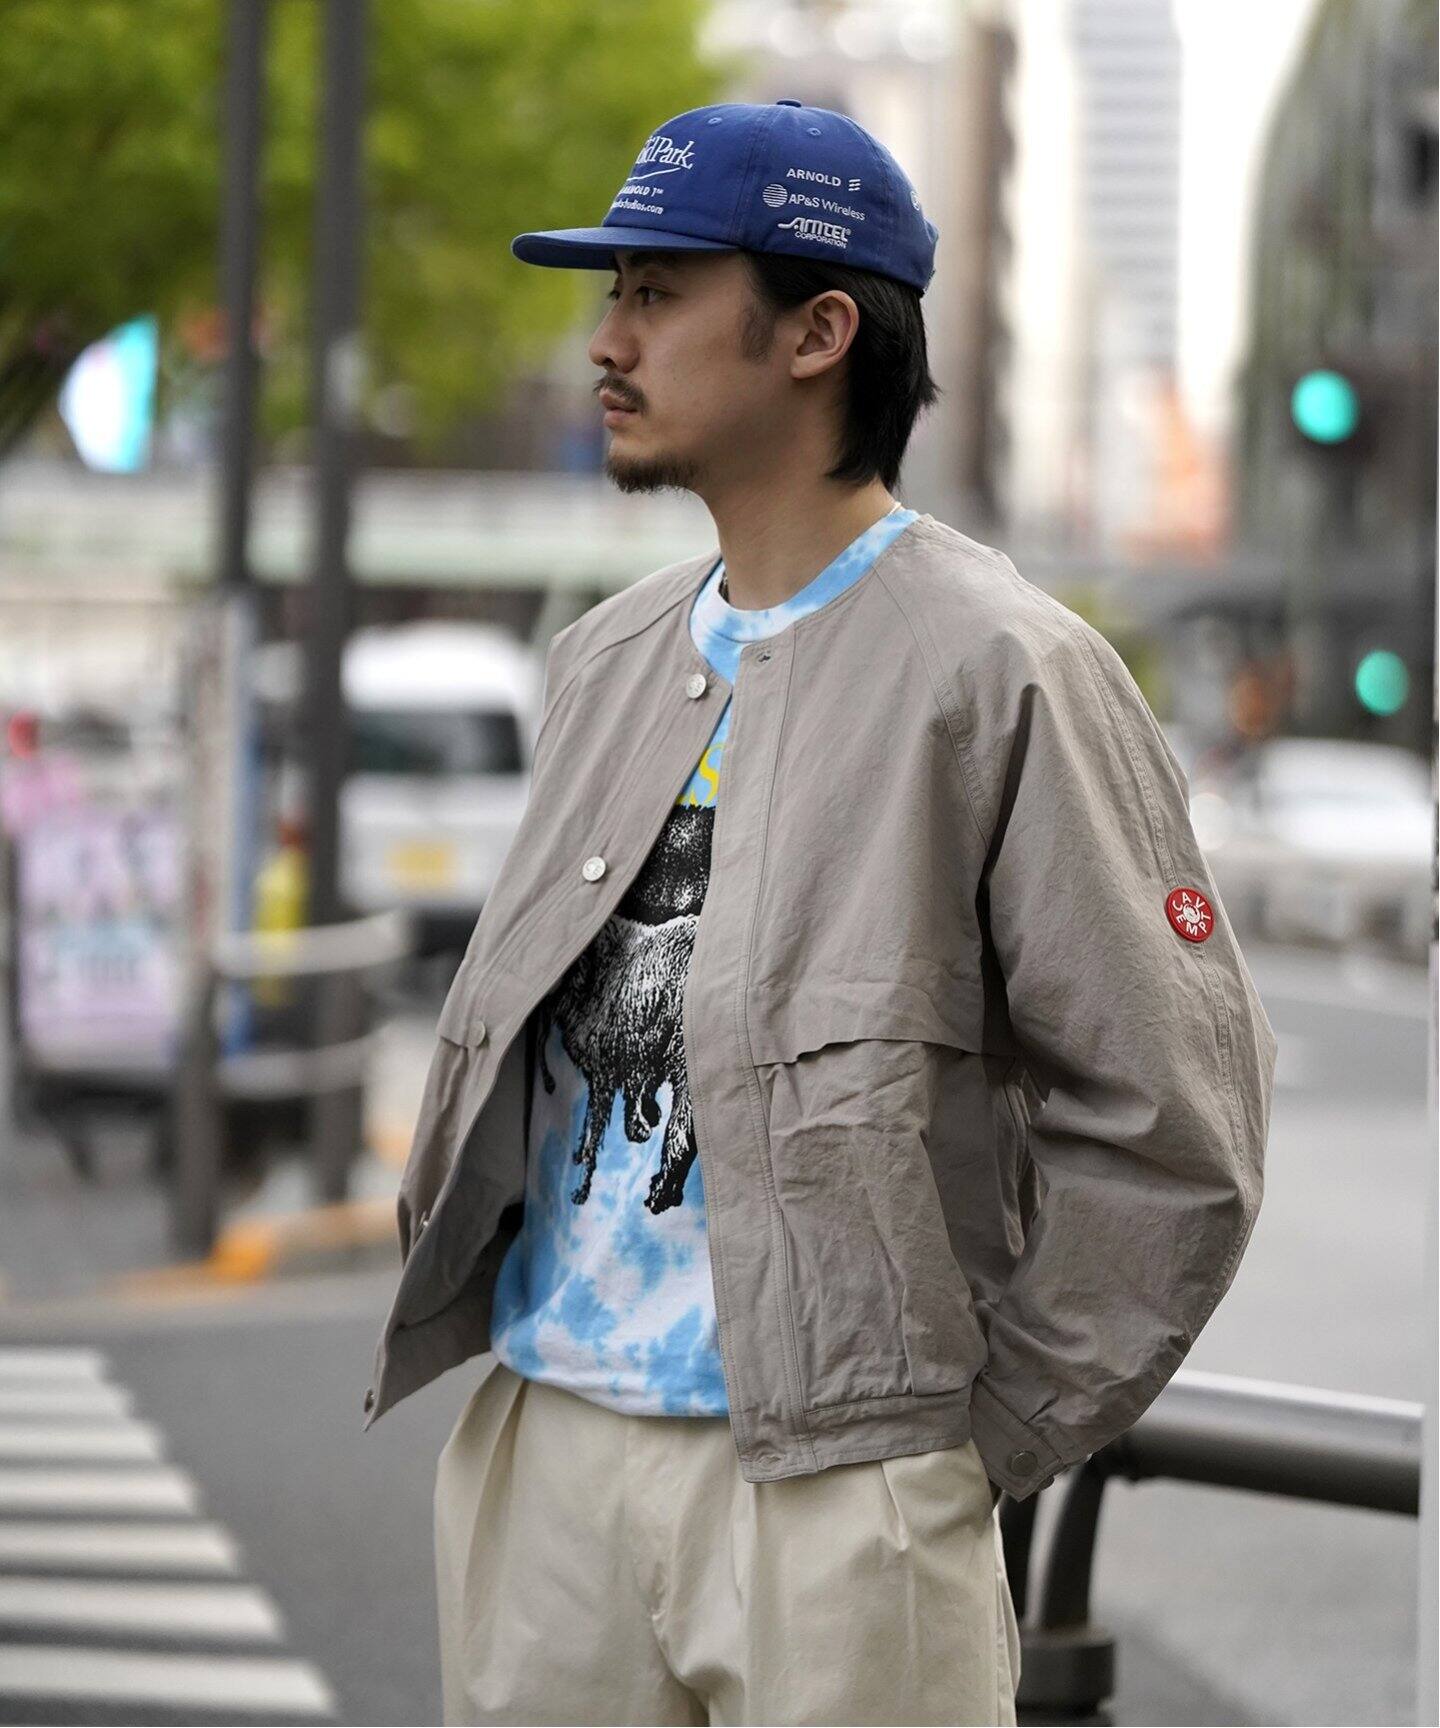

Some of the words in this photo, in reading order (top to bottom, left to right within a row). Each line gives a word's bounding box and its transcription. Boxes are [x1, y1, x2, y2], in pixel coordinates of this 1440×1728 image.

[786, 168, 841, 187] ARNOLD
[788, 194, 820, 208] AP&S
[821, 199, 865, 221] Wireless
[794, 231, 847, 249] CORPORATION
